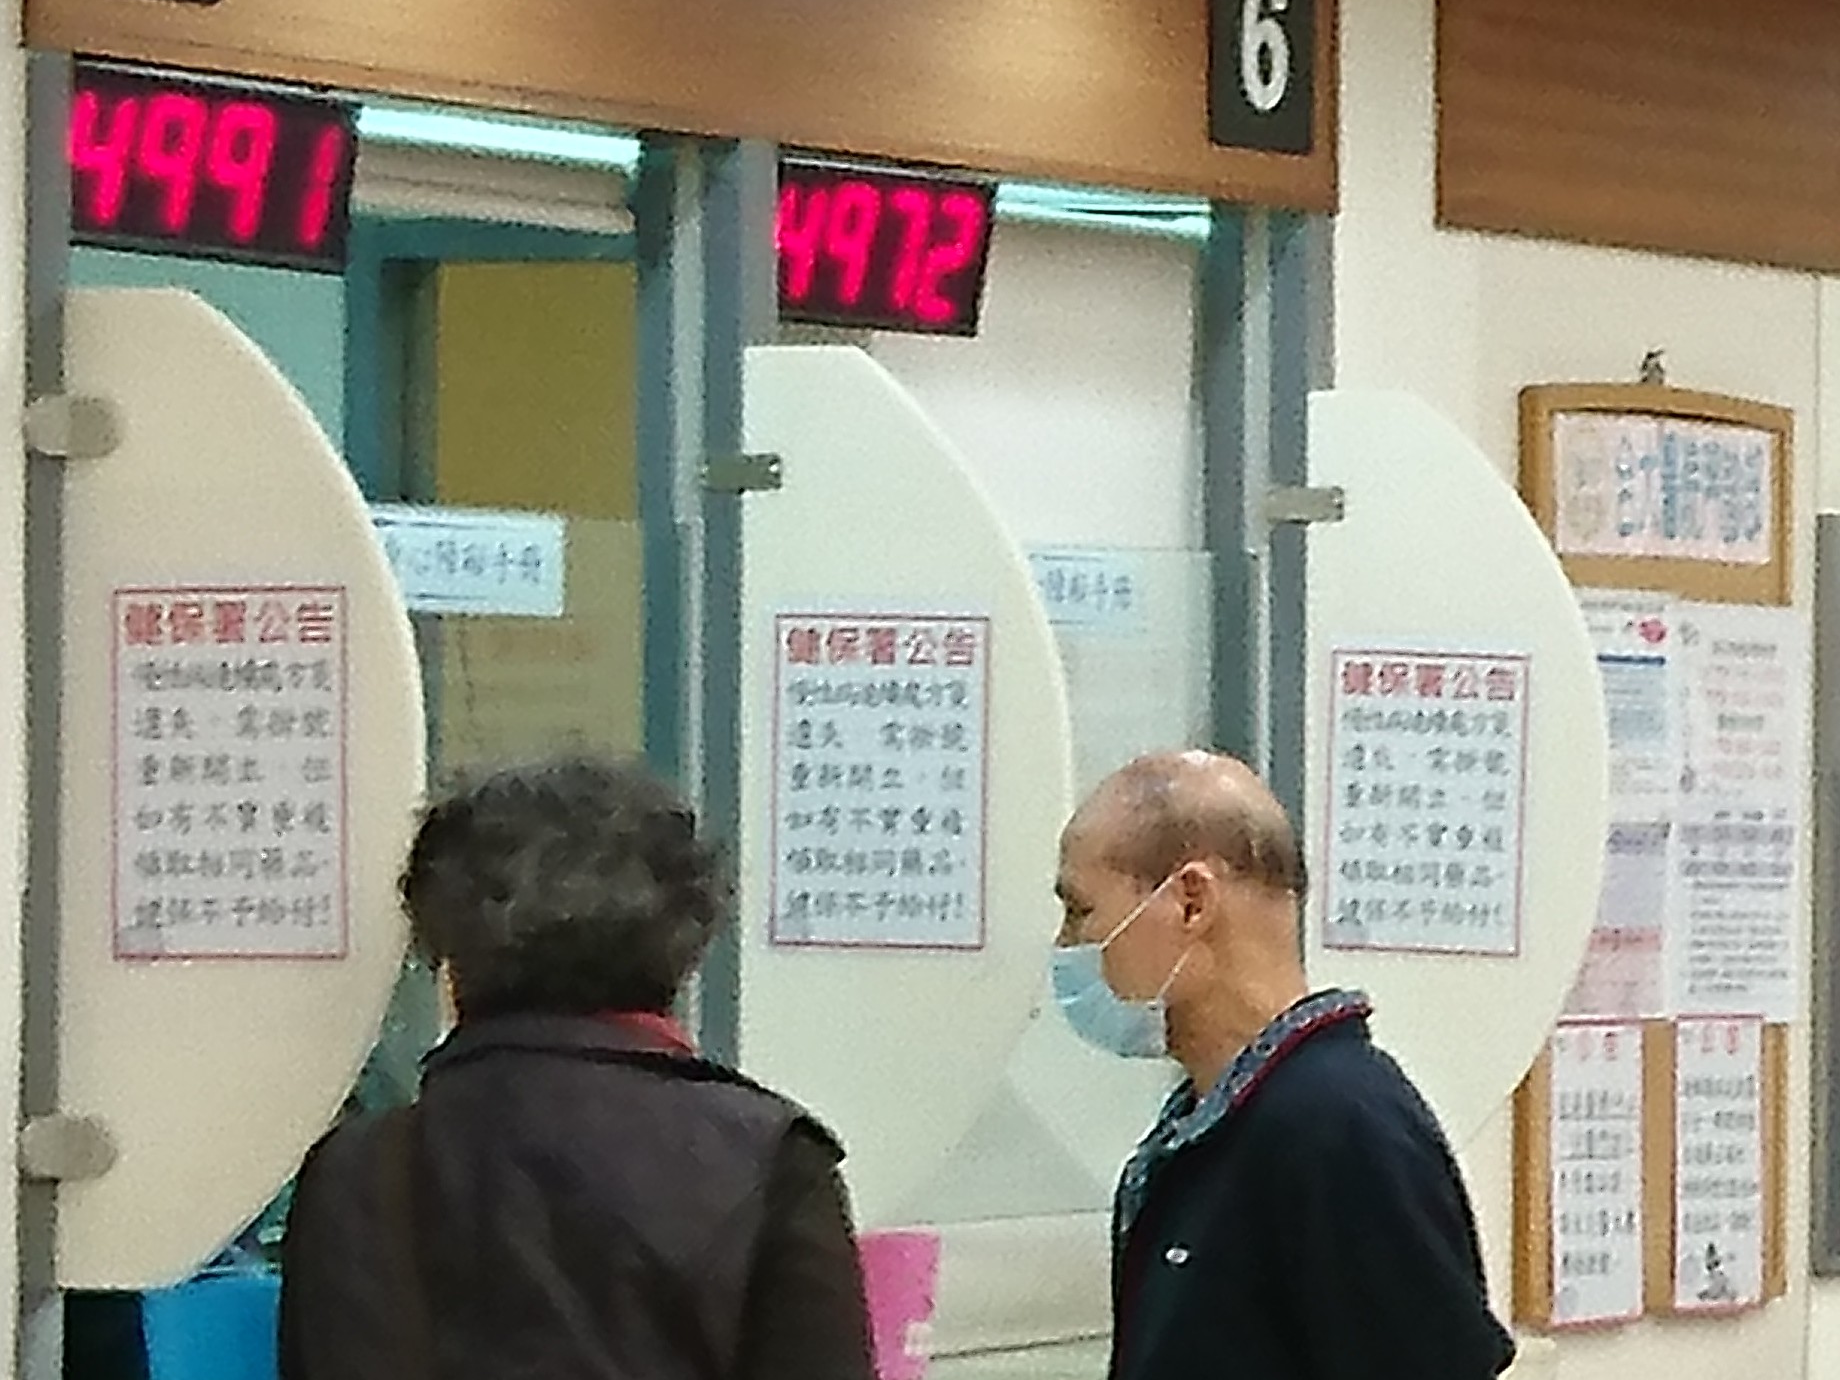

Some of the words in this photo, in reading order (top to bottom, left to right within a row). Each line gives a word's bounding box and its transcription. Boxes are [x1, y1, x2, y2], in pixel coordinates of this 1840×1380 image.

[64, 89, 340, 244] 4991
[772, 178, 985, 325] 4972
[126, 601, 334, 645] 健保署公告
[786, 626, 976, 666] 健保署公告
[1341, 660, 1516, 701] 健保署公告
